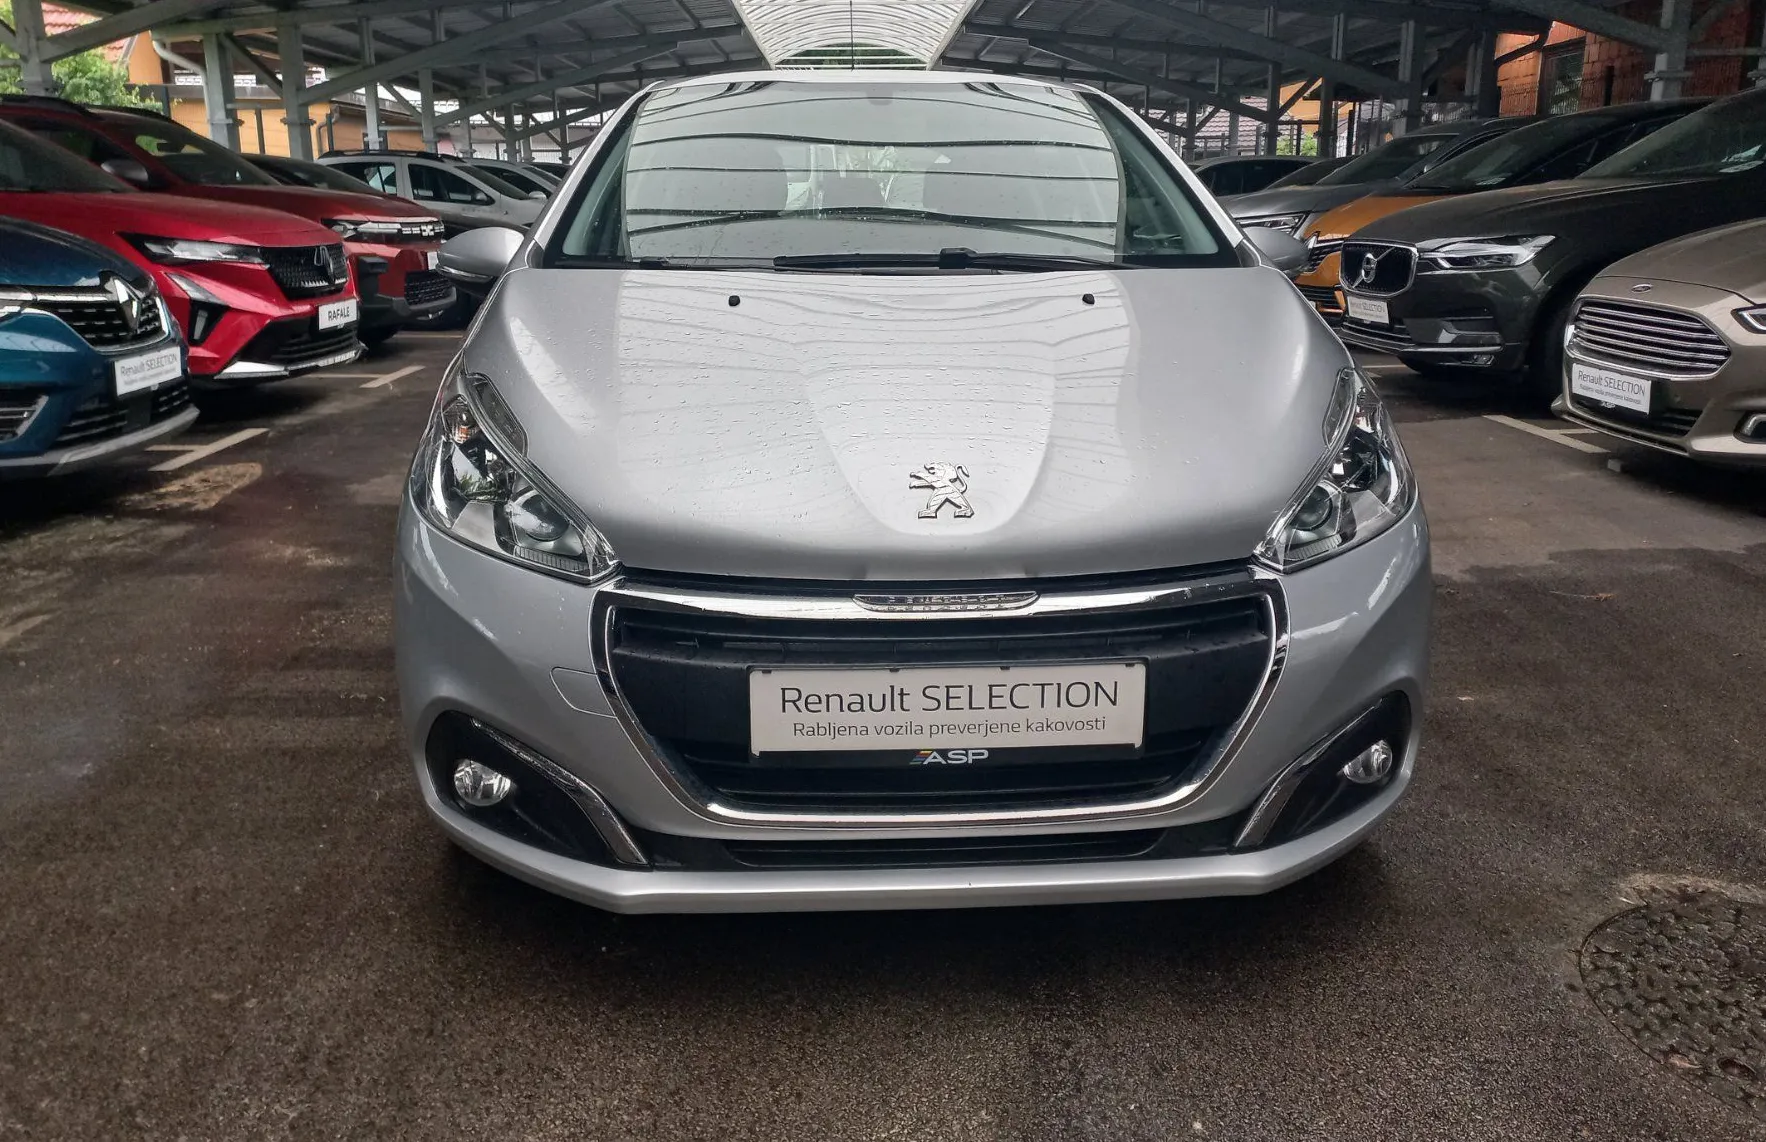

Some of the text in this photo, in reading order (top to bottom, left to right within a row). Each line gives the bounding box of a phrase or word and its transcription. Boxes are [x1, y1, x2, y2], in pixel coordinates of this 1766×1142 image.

[327, 306, 350, 321] RAFALE
[145, 354, 178, 371] SELECTION
[1578, 370, 1603, 386] Renault
[1603, 376, 1646, 396] SELECTION
[780, 681, 1118, 713] Renault SELECTION
[792, 716, 1107, 740] Rabljena vozila preverjene kakovosti
[922, 749, 989, 765] ASP
